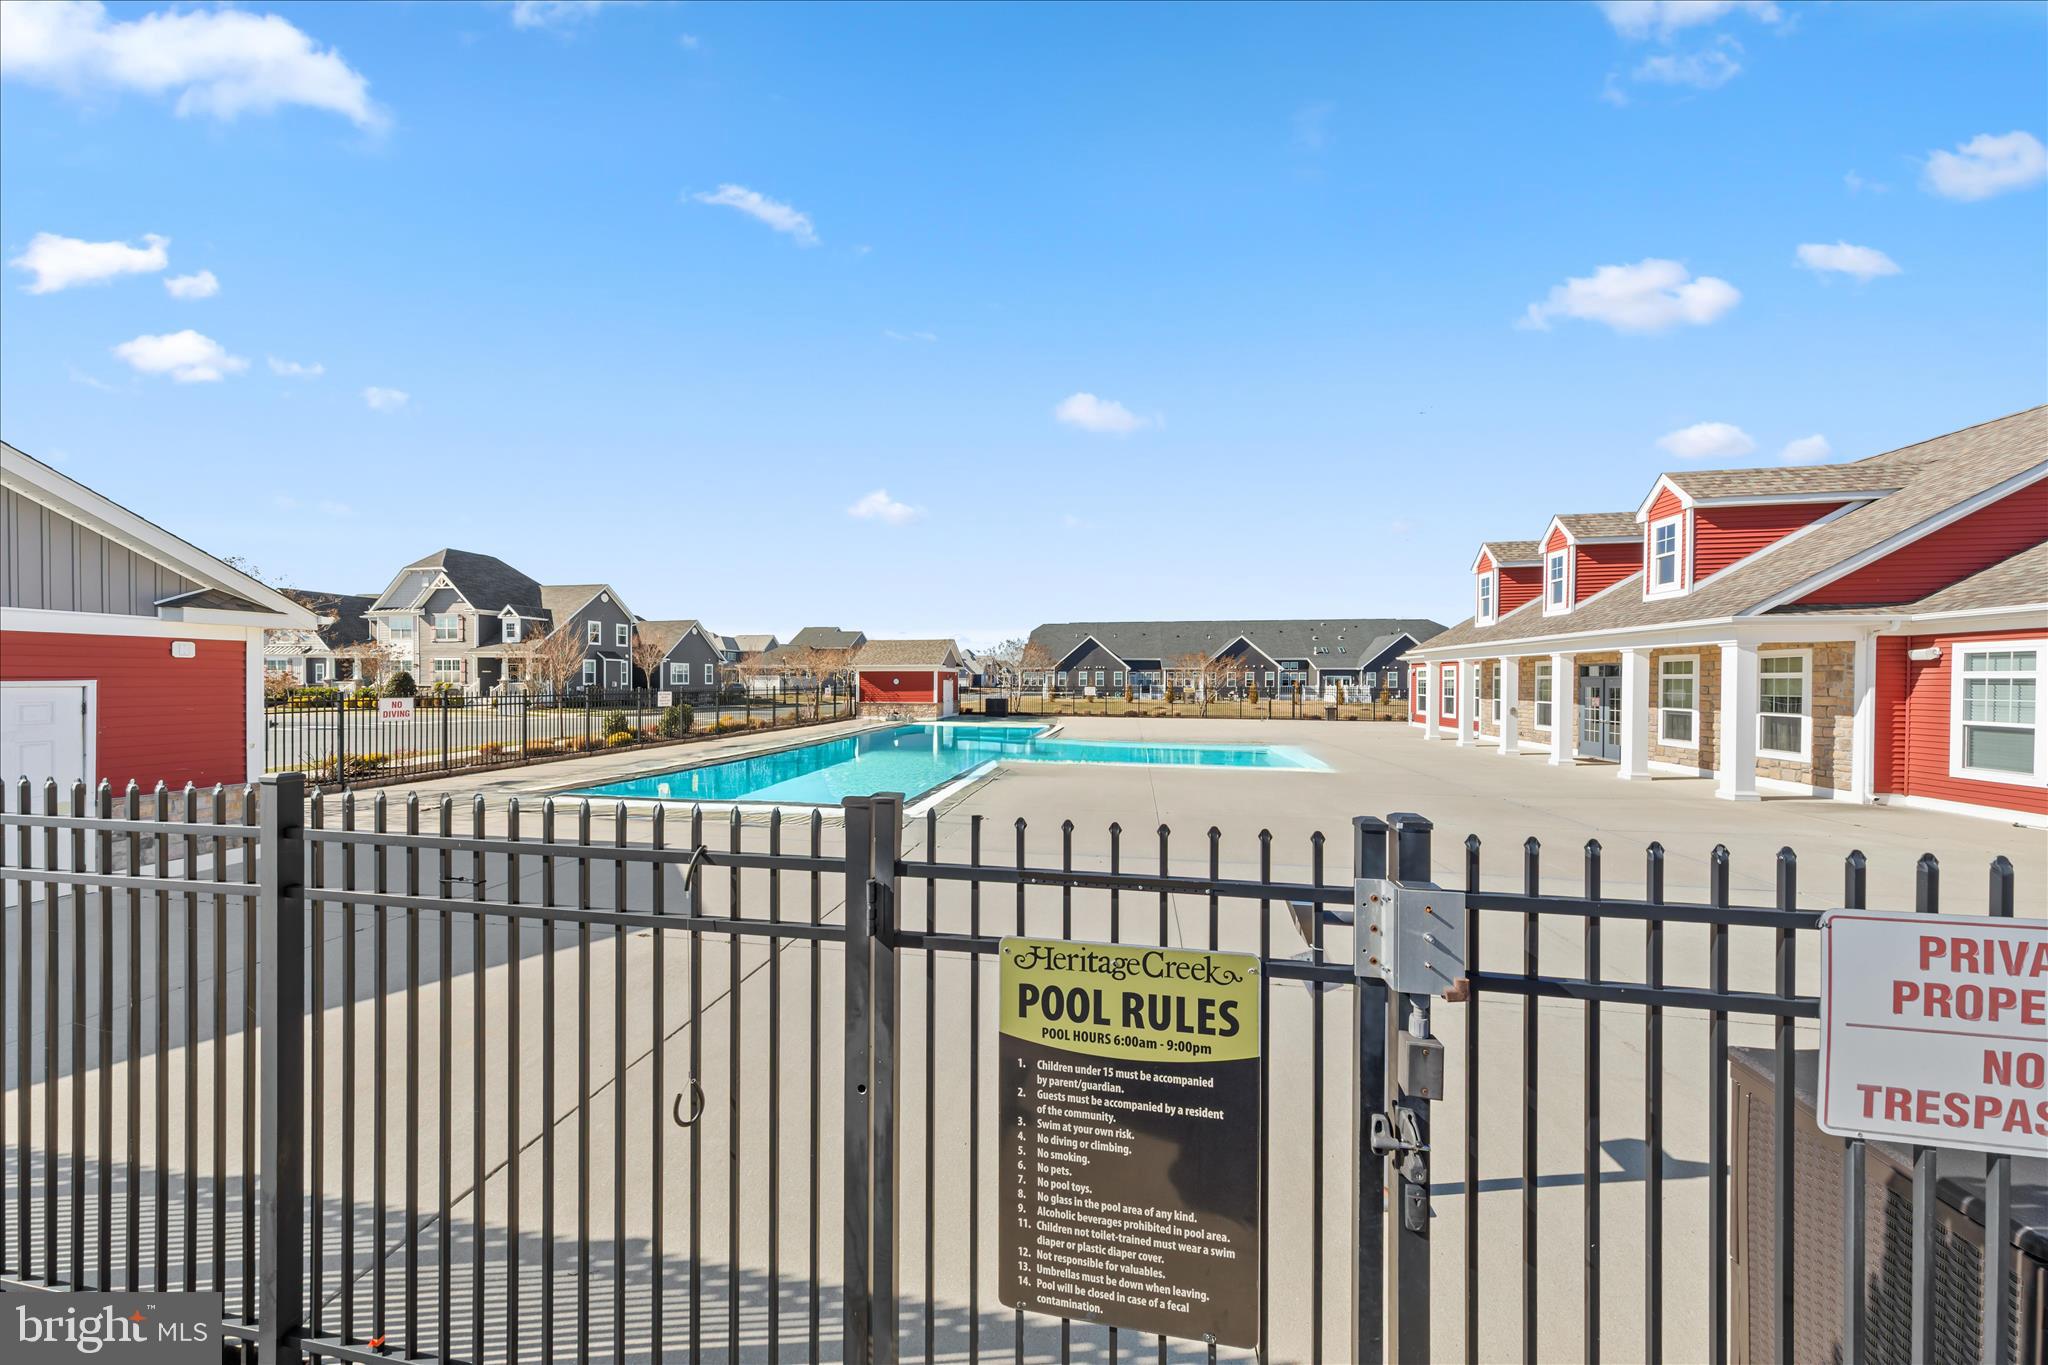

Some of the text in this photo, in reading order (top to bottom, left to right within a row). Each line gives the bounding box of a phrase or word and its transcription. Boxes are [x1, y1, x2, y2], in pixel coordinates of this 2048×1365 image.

[383, 710, 410, 718] DIVING
[1018, 983, 1240, 1037] POOL RULES
[1892, 980, 2046, 1025] PROPE
[1042, 1027, 1070, 1040] POOL
[1073, 1030, 1111, 1045] HOURS
[1114, 1035, 1157, 1049] 6:00am
[1167, 1040, 1212, 1055] 9:00pm
[1018, 1058, 1213, 1088] 1. Children under 15 must be accompanied
[1037, 1074, 1124, 1093] by parent/guardian.
[1983, 1049, 2045, 1089] NO
[1017, 1088, 1224, 1120] 2. Guests must be accompanied by a resident
[1037, 1105, 1116, 1124] of the community.
[1018, 1116, 1134, 1140] 3. Swim at your own risk.
[1018, 1132, 1132, 1156] 4. No diving or climbing.
[1018, 1146, 1090, 1166] 5. No smoking.
[1018, 1160, 1072, 1176] 6. No pets.
[1018, 1175, 1092, 1194] 7. No pool toys.
[1018, 1189, 1197, 1223] 8. No glass in the pool area of any kind.
[1018, 1204, 1230, 1242] 9. Alcoholic beverages prohibited in pool area.
[1018, 1218, 1235, 1259] 11. Children not toilet-trained must wear a swim
[1037, 1236, 1164, 1264] diaper or plastic diaper cover.
[1018, 1247, 1165, 1279] 12. Not responsible for valuables.
[1018, 1261, 1210, 1303] 13. Umbrellas must be down when leaving.
[1018, 1276, 1189, 1313] 14. Pool will be closed in case of a fecal
[1037, 1295, 1103, 1314] contamination.
